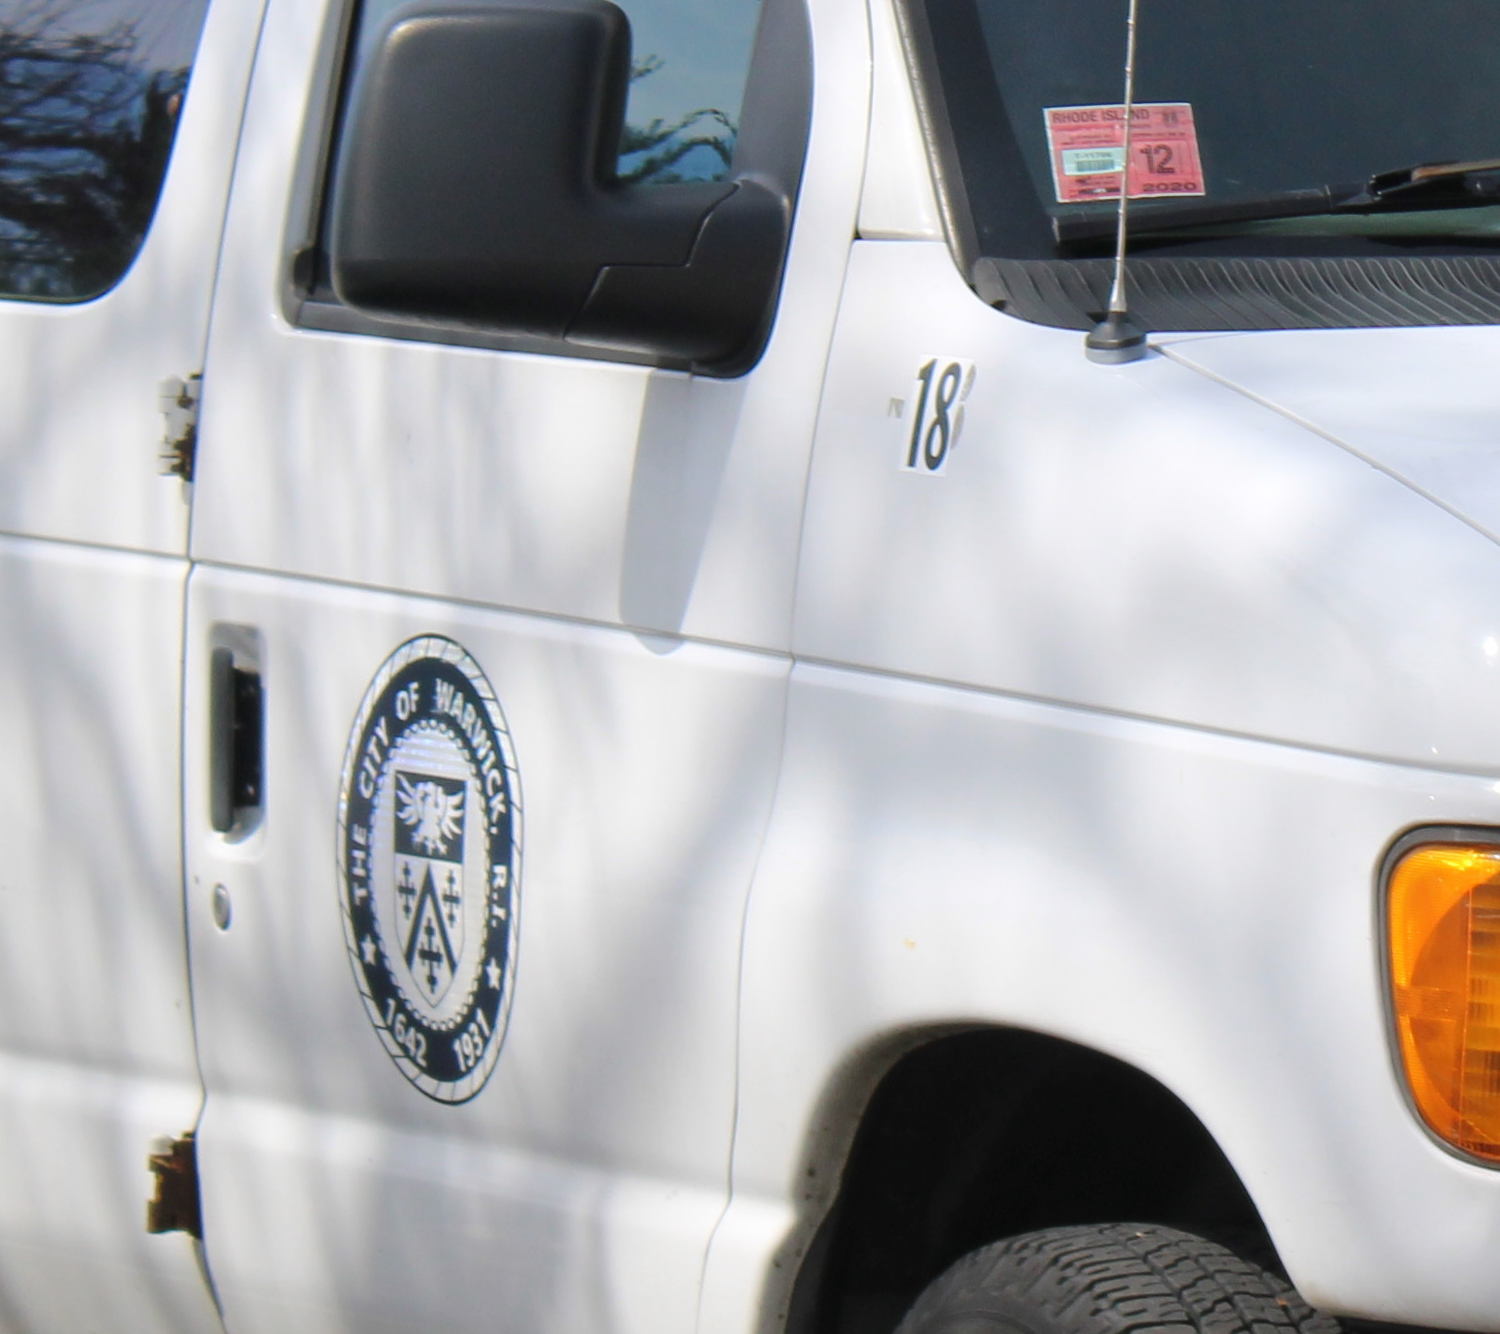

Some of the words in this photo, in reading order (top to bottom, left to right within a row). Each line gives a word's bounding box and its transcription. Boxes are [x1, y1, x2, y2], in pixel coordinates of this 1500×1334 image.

[1053, 110, 1097, 122] RHODE
[1103, 109, 1149, 121] ISLND
[1140, 144, 1175, 174] 12
[1143, 182, 1196, 192] 2020
[907, 358, 962, 470] 18
[395, 682, 420, 721] OF
[357, 716, 389, 800] CITY
[352, 824, 367, 905] THE
[492, 865, 507, 927] R.I.
[384, 998, 428, 1067] 1642
[453, 1008, 491, 1072] 1931
